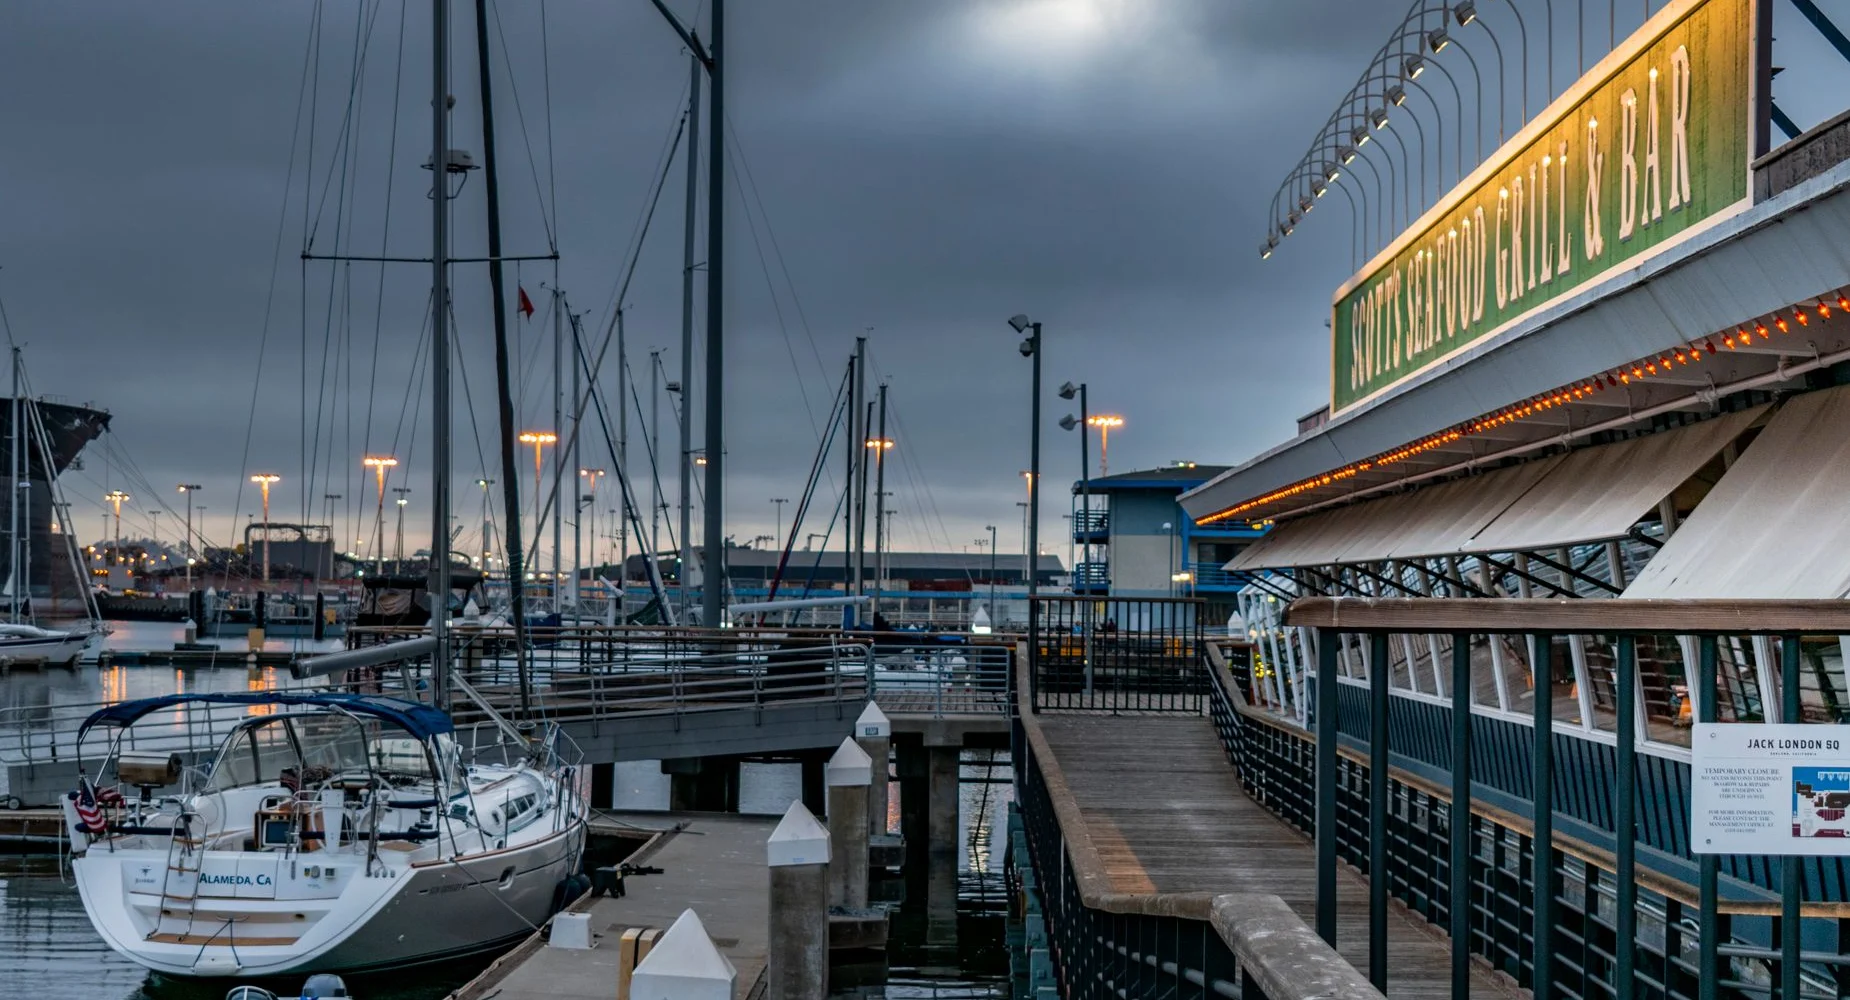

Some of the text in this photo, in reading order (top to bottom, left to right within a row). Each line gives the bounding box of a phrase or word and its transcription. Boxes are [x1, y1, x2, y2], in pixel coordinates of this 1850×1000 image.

[1352, 45, 1692, 391] SCOTT'S SEAFOOD GRILL & BAR
[1747, 738, 1840, 751] JACK LONDON SQ
[1704, 767, 1747, 775] TEMPORARY
